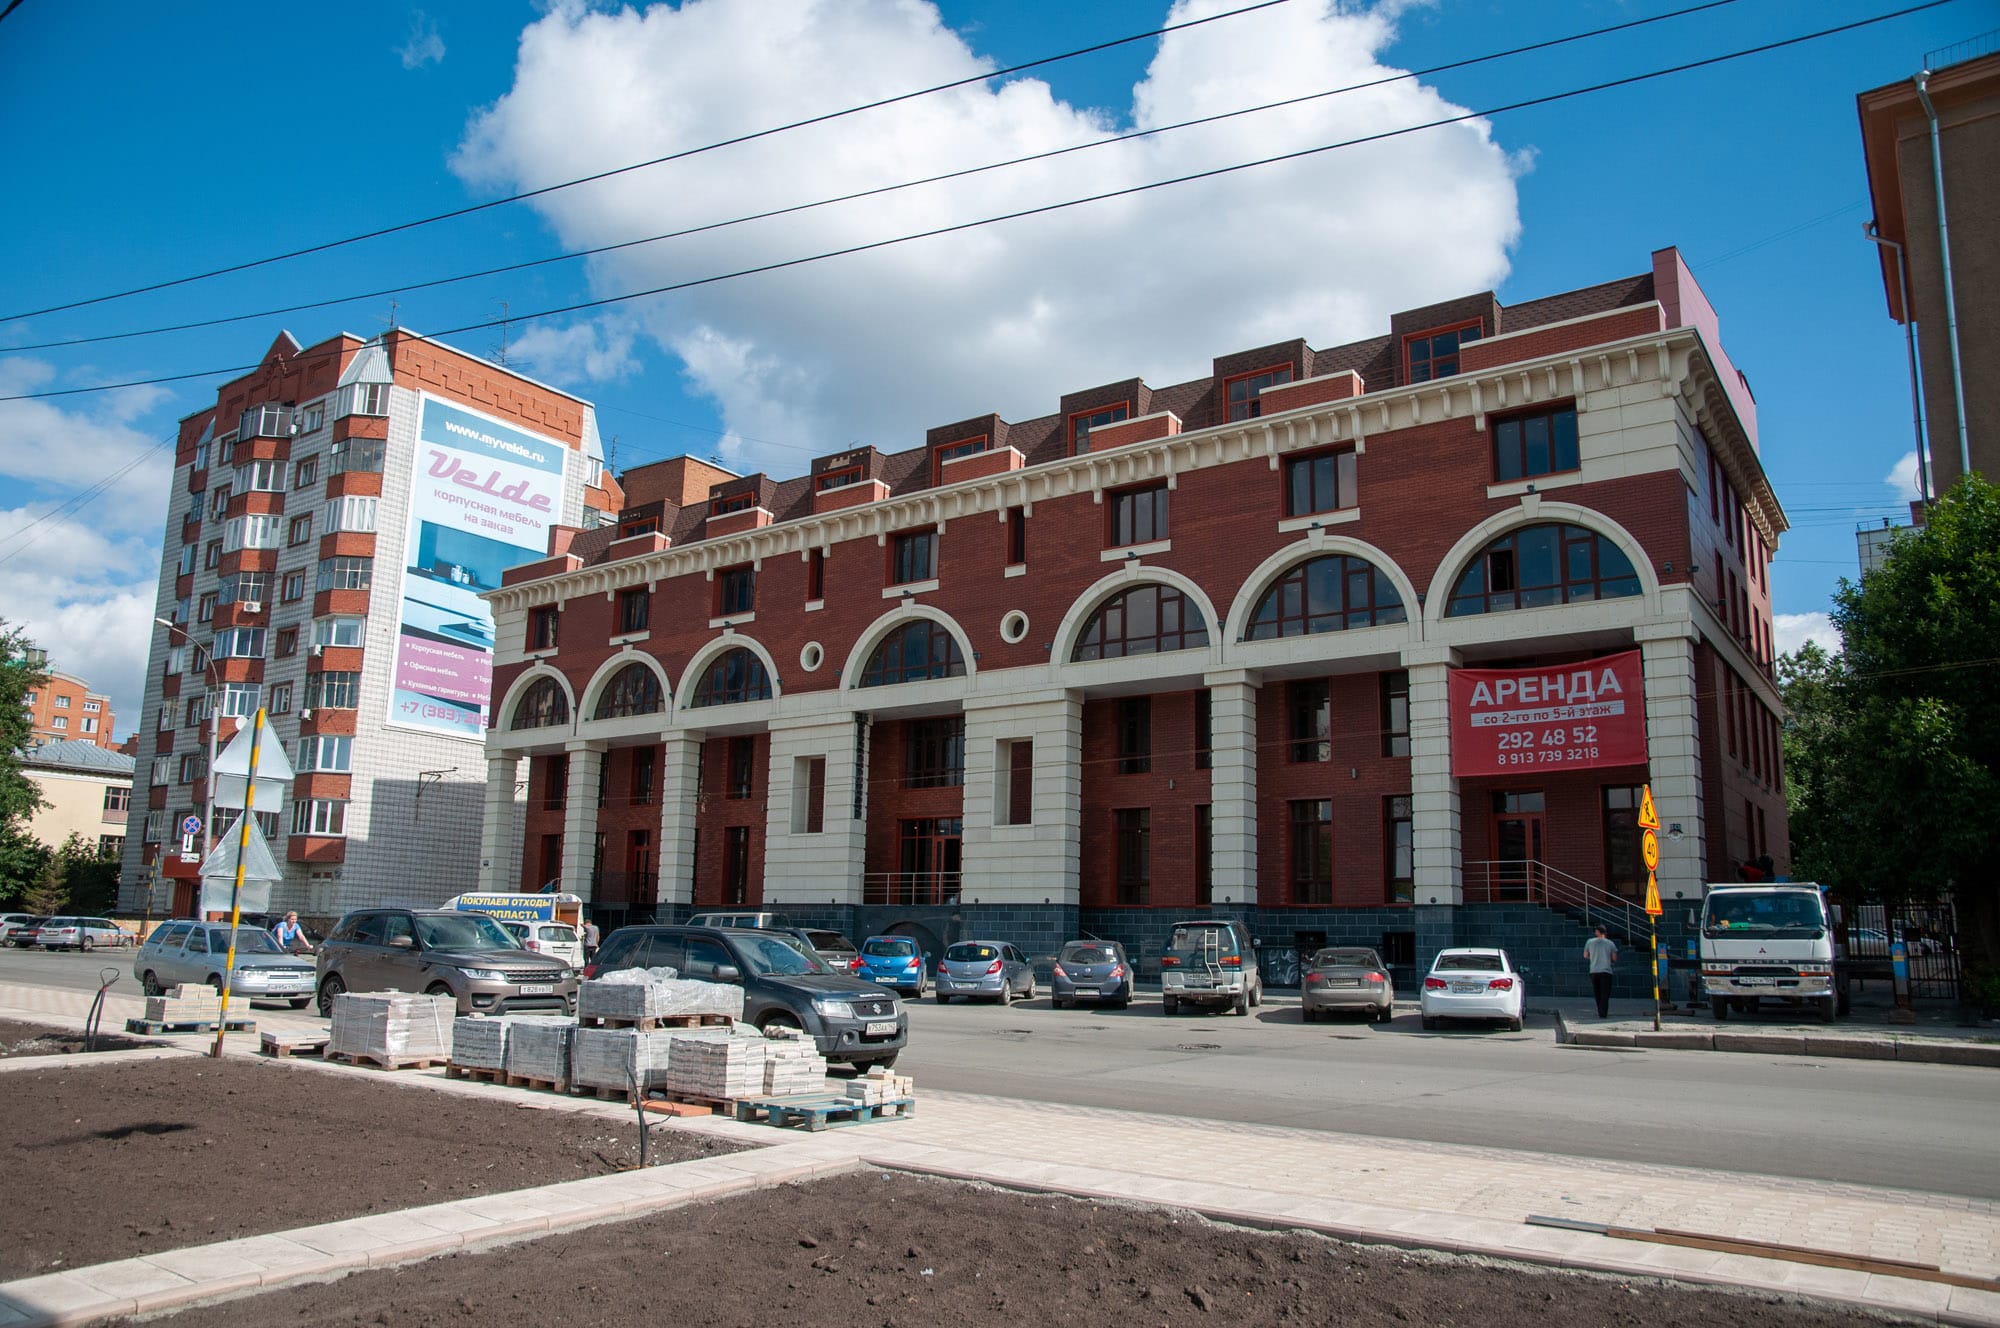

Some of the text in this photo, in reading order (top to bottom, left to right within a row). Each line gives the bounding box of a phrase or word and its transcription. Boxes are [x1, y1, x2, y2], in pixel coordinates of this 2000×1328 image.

[445, 421, 545, 463] www.myvelde.ru
[428, 449, 552, 513] Velde
[464, 513, 514, 535] на заказ
[499, 510, 542, 529] мебель
[411, 643, 465, 661] Корпусная мебель
[409, 661, 459, 677] Офисная мебель
[407, 680, 469, 698] Кухонные гарнитуры
[1469, 667, 1623, 708] АРЕНДА
[400, 701, 420, 714] +7
[421, 703, 462, 724] (383)
[1483, 704, 1611, 724] со 2-го по 5-й этаж
[1498, 725, 1598, 750] 292 48 52
[1498, 747, 1599, 765] 8 913 739 3218
[1646, 842, 1656, 858] 40
[460, 896, 552, 907] ПОКУПАЕМ ОТХОДЫ
